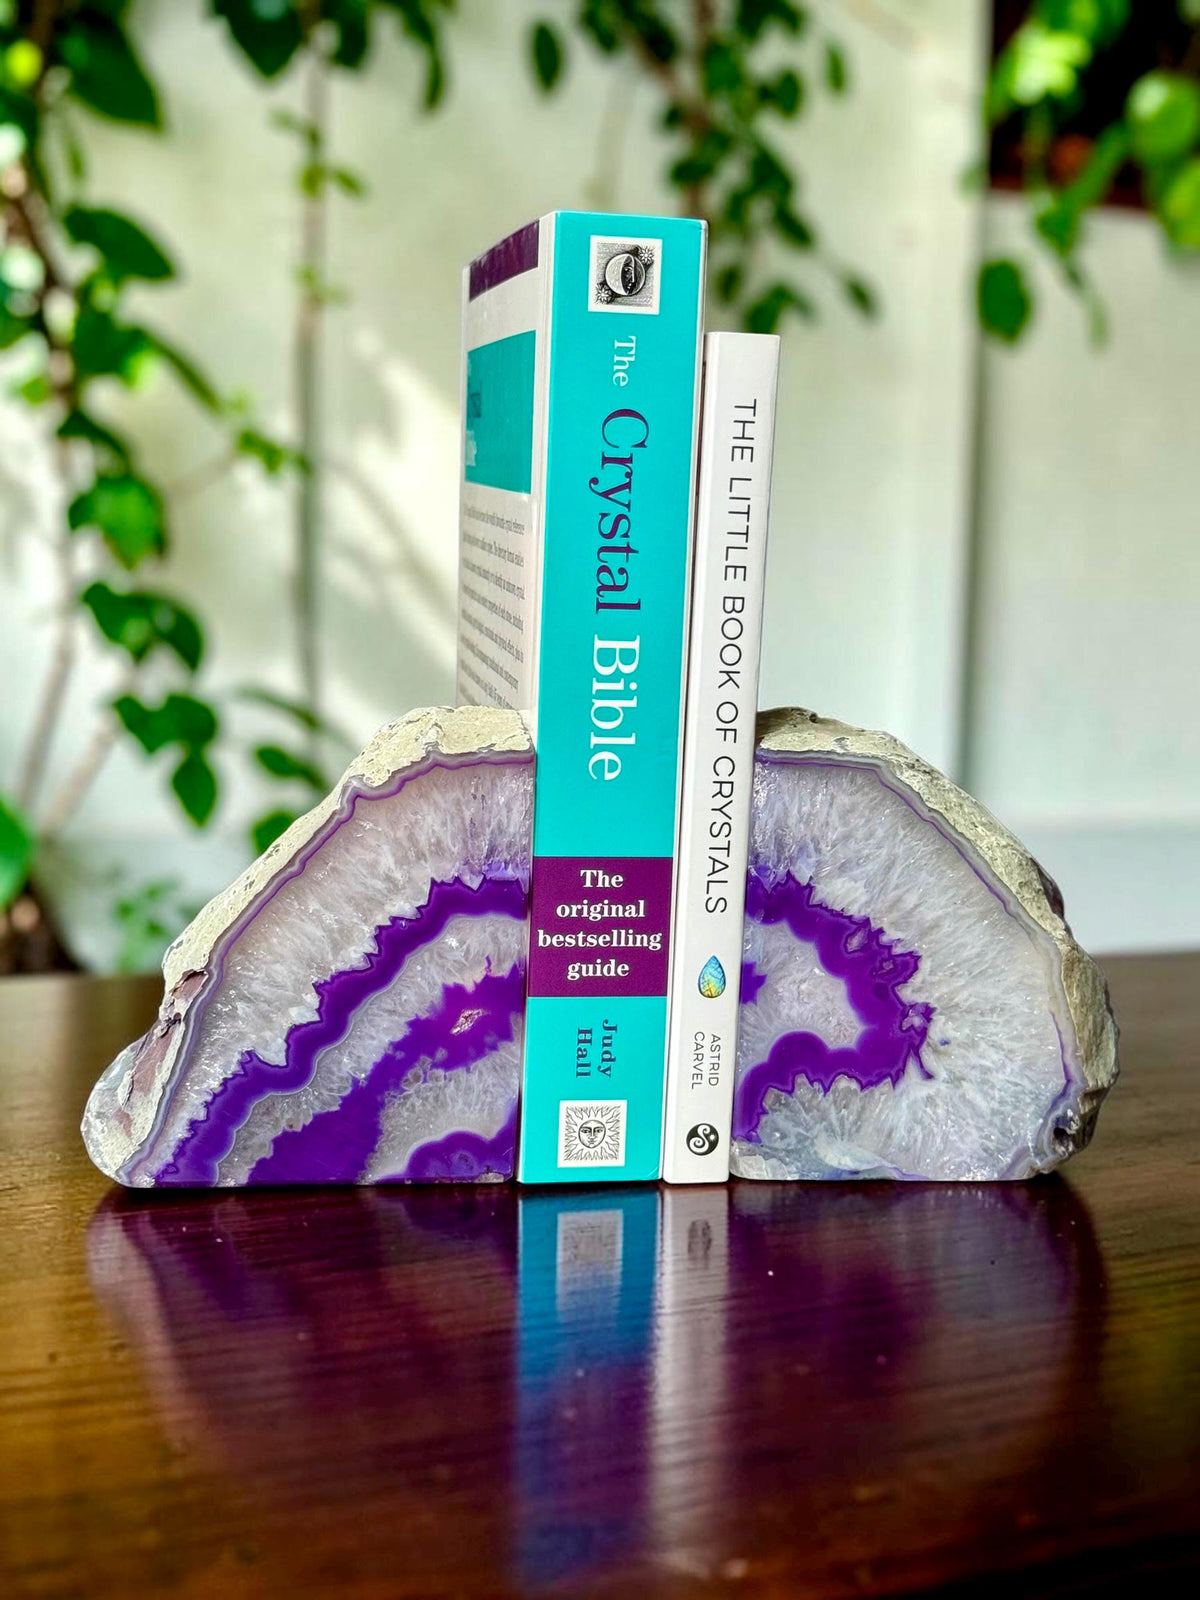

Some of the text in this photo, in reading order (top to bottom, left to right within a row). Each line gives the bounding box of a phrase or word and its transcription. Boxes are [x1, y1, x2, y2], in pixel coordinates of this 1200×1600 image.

[588, 335, 649, 782] The Crystal Bible
[704, 398, 757, 914] THE LITTLE BOOK OF CRYSTALS
[580, 869, 624, 888] The
[556, 899, 646, 922] original
[537, 928, 663, 951] bestselling
[567, 958, 630, 981] guide
[575, 1028, 593, 1078] Hall
[597, 1019, 618, 1078] Judy
[691, 1031, 706, 1090] CARVEL
[708, 1033, 721, 1087] ASTRID
